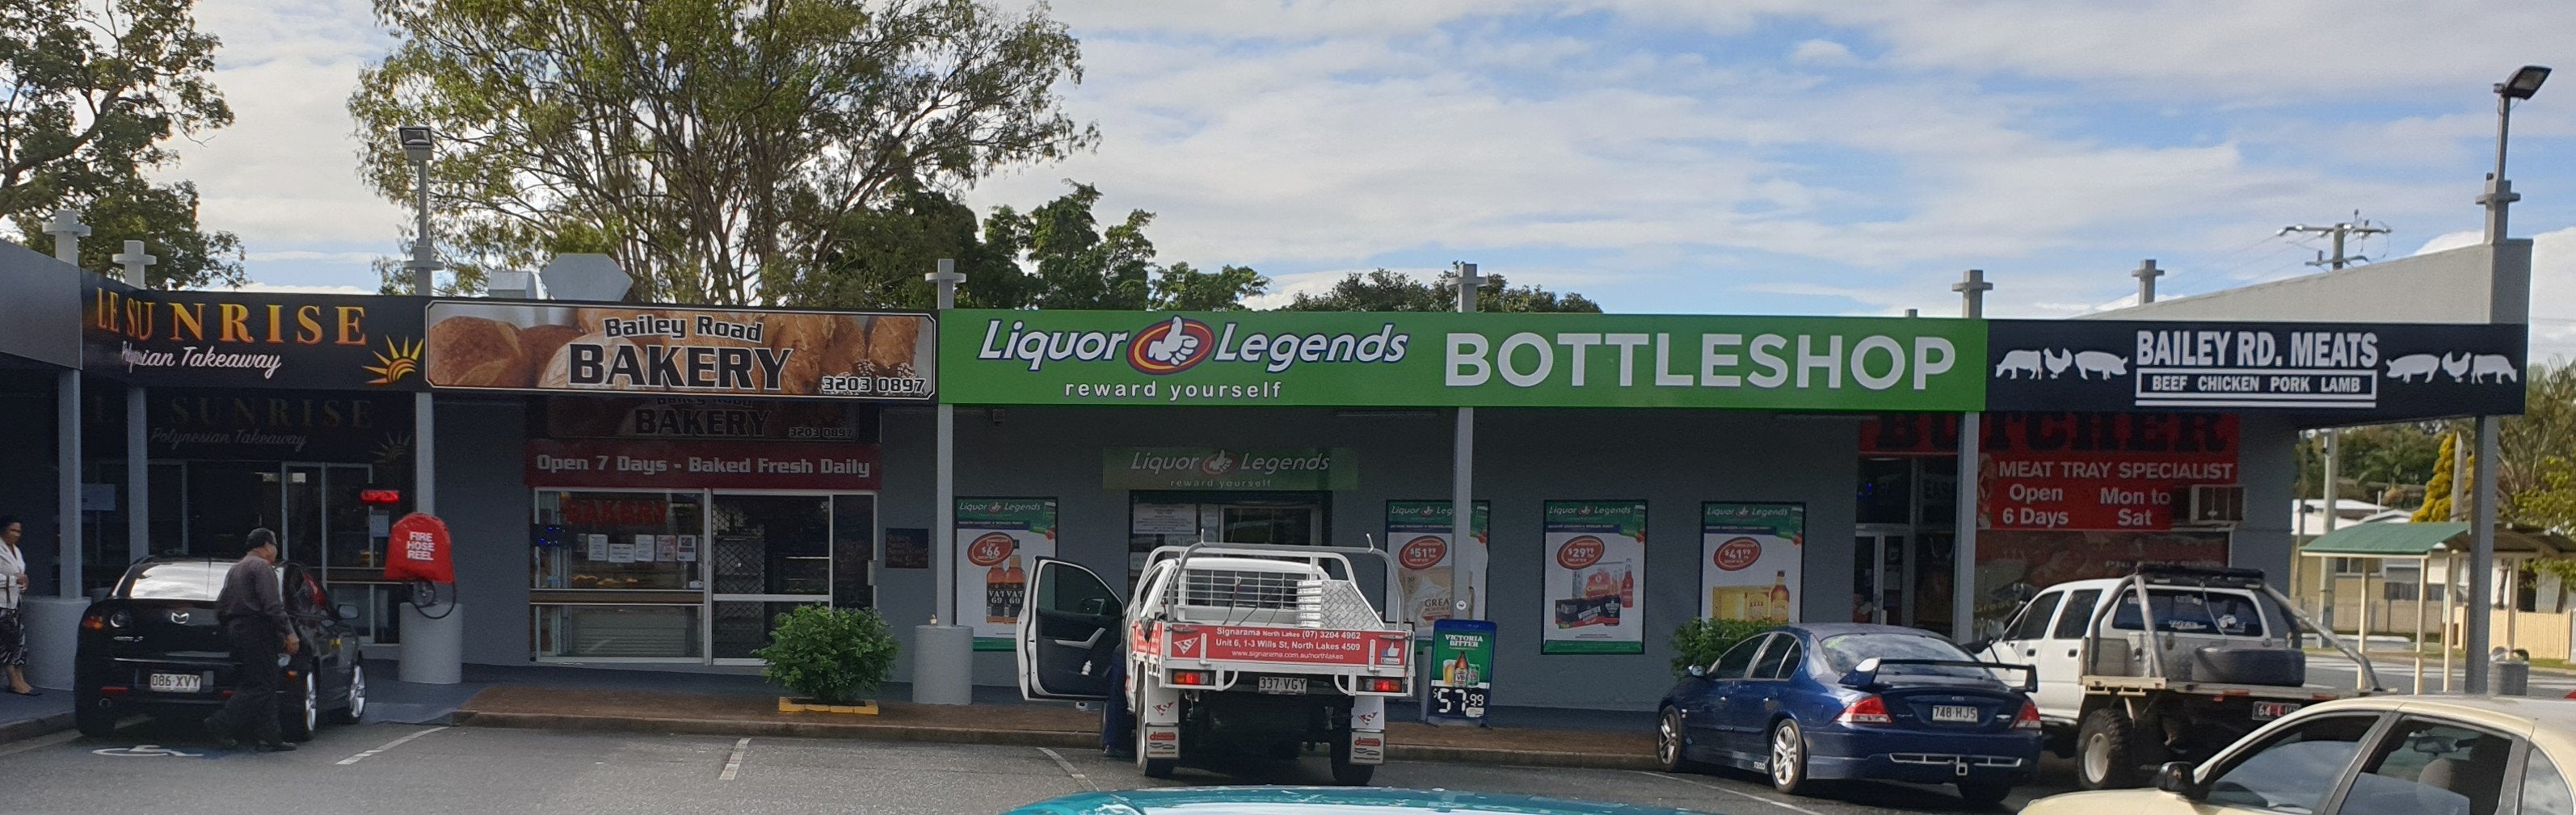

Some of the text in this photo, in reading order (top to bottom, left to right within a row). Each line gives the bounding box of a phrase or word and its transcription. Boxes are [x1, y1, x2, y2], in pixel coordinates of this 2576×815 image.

[97, 287, 367, 346] LE SUNRISE
[604, 315, 763, 343] Bailey Road
[977, 317, 1411, 373] Liquor Legends
[2136, 330, 2378, 368] BAILEY RD. MEATS
[183, 345, 282, 380] Takeaway
[567, 342, 794, 392] BAKERY
[1443, 331, 1956, 391] BOTTLESHOP
[822, 375, 927, 394] 3203 0897
[1065, 380, 1282, 401] reward yourself
[2152, 375, 2361, 393] BEEF CHICKEN PORK LAMB
[634, 409, 771, 438] BAKERY
[537, 454, 589, 473] Open
[596, 455, 609, 470] 7
[617, 456, 668, 476] Days
[688, 456, 751, 474] Baked
[758, 457, 814, 475] Fresh
[820, 458, 871, 478] Daily
[1131, 452, 1330, 476] Liquor Legends
[1999, 461, 2234, 481] MEAT TRAY SPECIALIST
[2009, 483, 2172, 506] Open Mon to
[959, 502, 1041, 512] Liquor Legends
[2002, 508, 2153, 528] 6 Days Sat
[406, 540, 436, 552] HOSE
[409, 531, 434, 542] FIRE
[407, 550, 434, 561] REEL
[1216, 627, 1261, 636] Signarama
[1302, 630, 1318, 640] (07)
[1445, 634, 1484, 642] VICTORIA
[1215, 638, 1232, 647] Unit
[1257, 640, 1277, 649] Wills
[1291, 641, 1314, 650] North
[1316, 641, 1340, 651] Lakes
